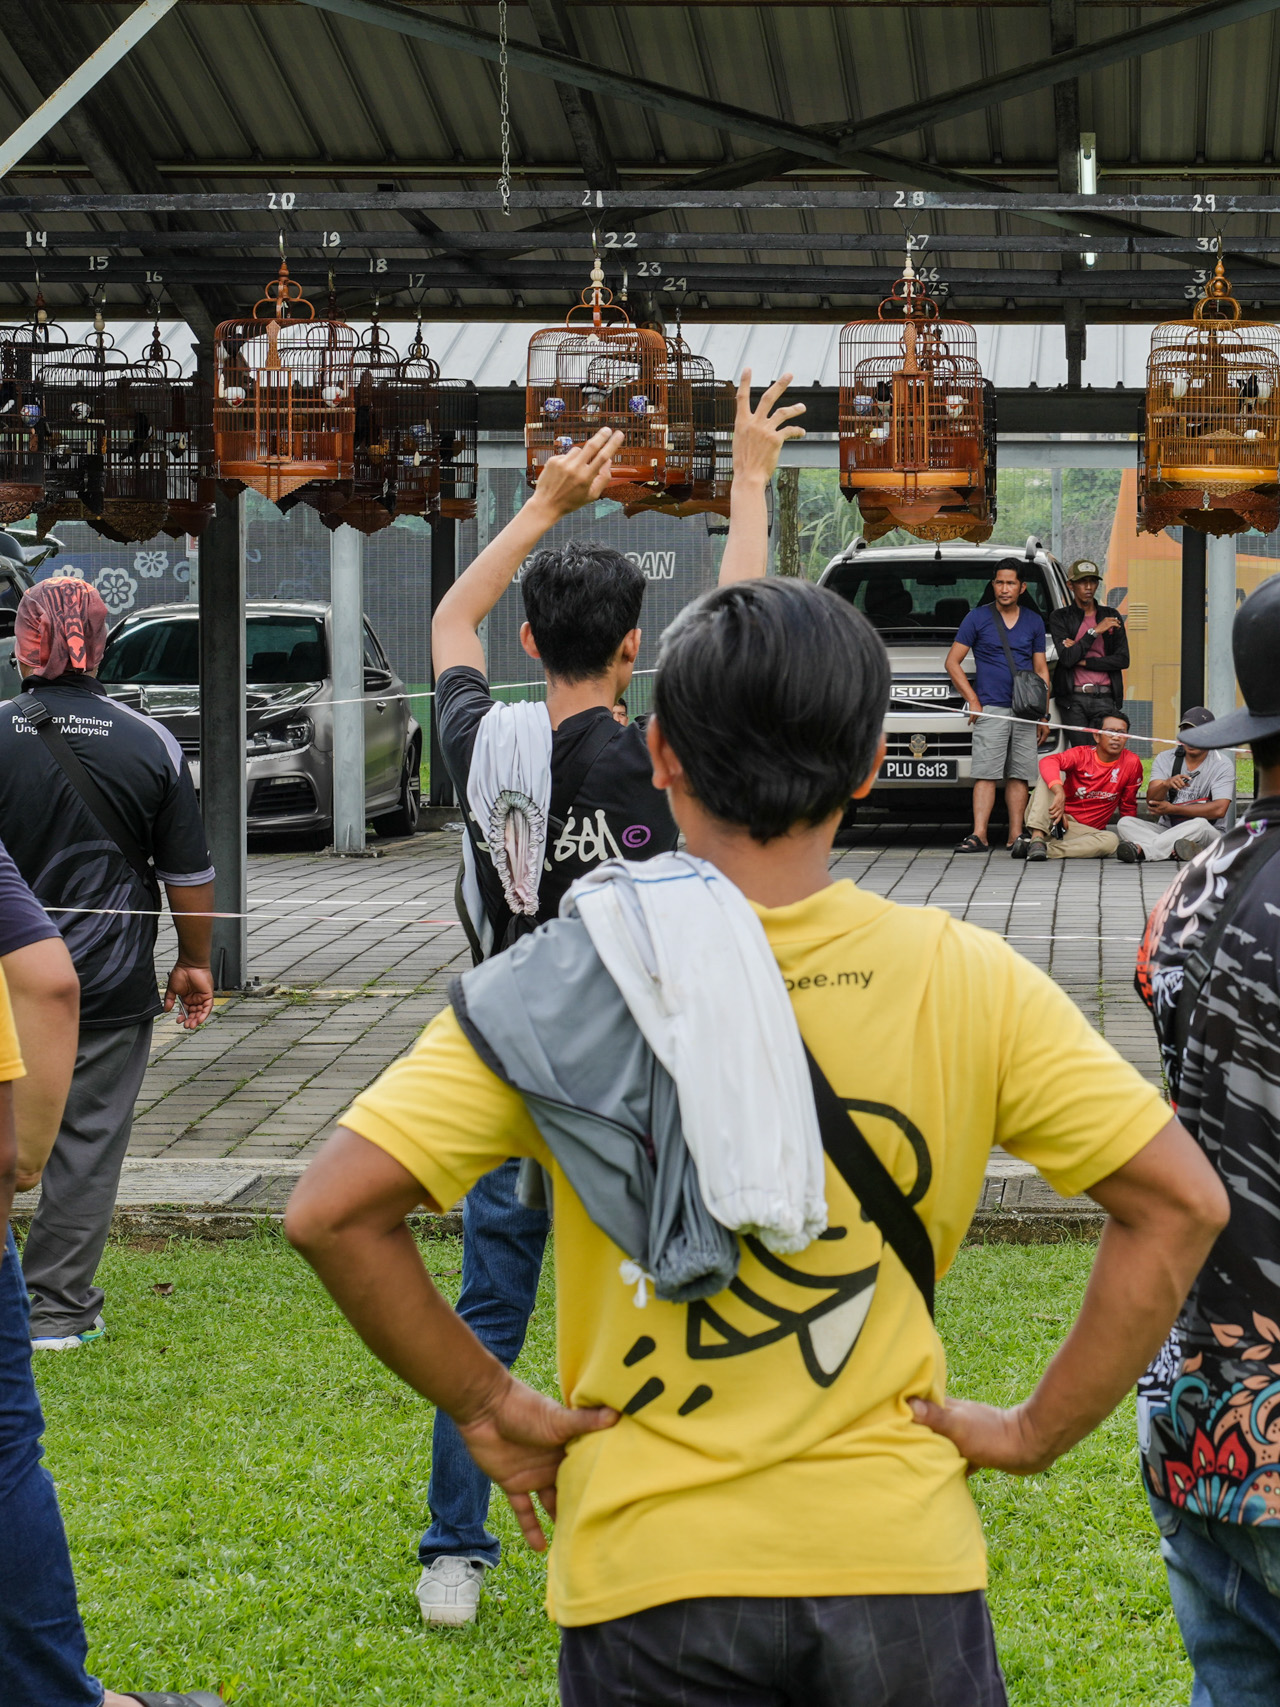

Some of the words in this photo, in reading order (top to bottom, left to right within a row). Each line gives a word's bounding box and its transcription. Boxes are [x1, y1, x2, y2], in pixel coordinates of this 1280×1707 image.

[267, 192, 295, 210] 20
[581, 191, 604, 208] 21
[893, 191, 925, 208] 28
[1192, 194, 1216, 212] 29
[25, 231, 47, 247] 14
[322, 231, 340, 247] 19
[604, 232, 638, 249] 22
[908, 235, 931, 250] 27
[1196, 237, 1220, 252] 30
[88, 256, 109, 271] 15
[370, 258, 387, 273] 18
[637, 262, 661, 276] 23
[145, 271, 162, 283] 16
[408, 273, 426, 287] 17
[918, 268, 940, 281] 26
[662, 278, 688, 292] 24
[929, 283, 949, 296] 25
[891, 687, 946, 697] ISUZU
[69, 714, 113, 728] Peminat
[60, 725, 109, 736] Malaysia
[886, 762, 912, 777] PLU
[917, 762, 948, 777] 6813
